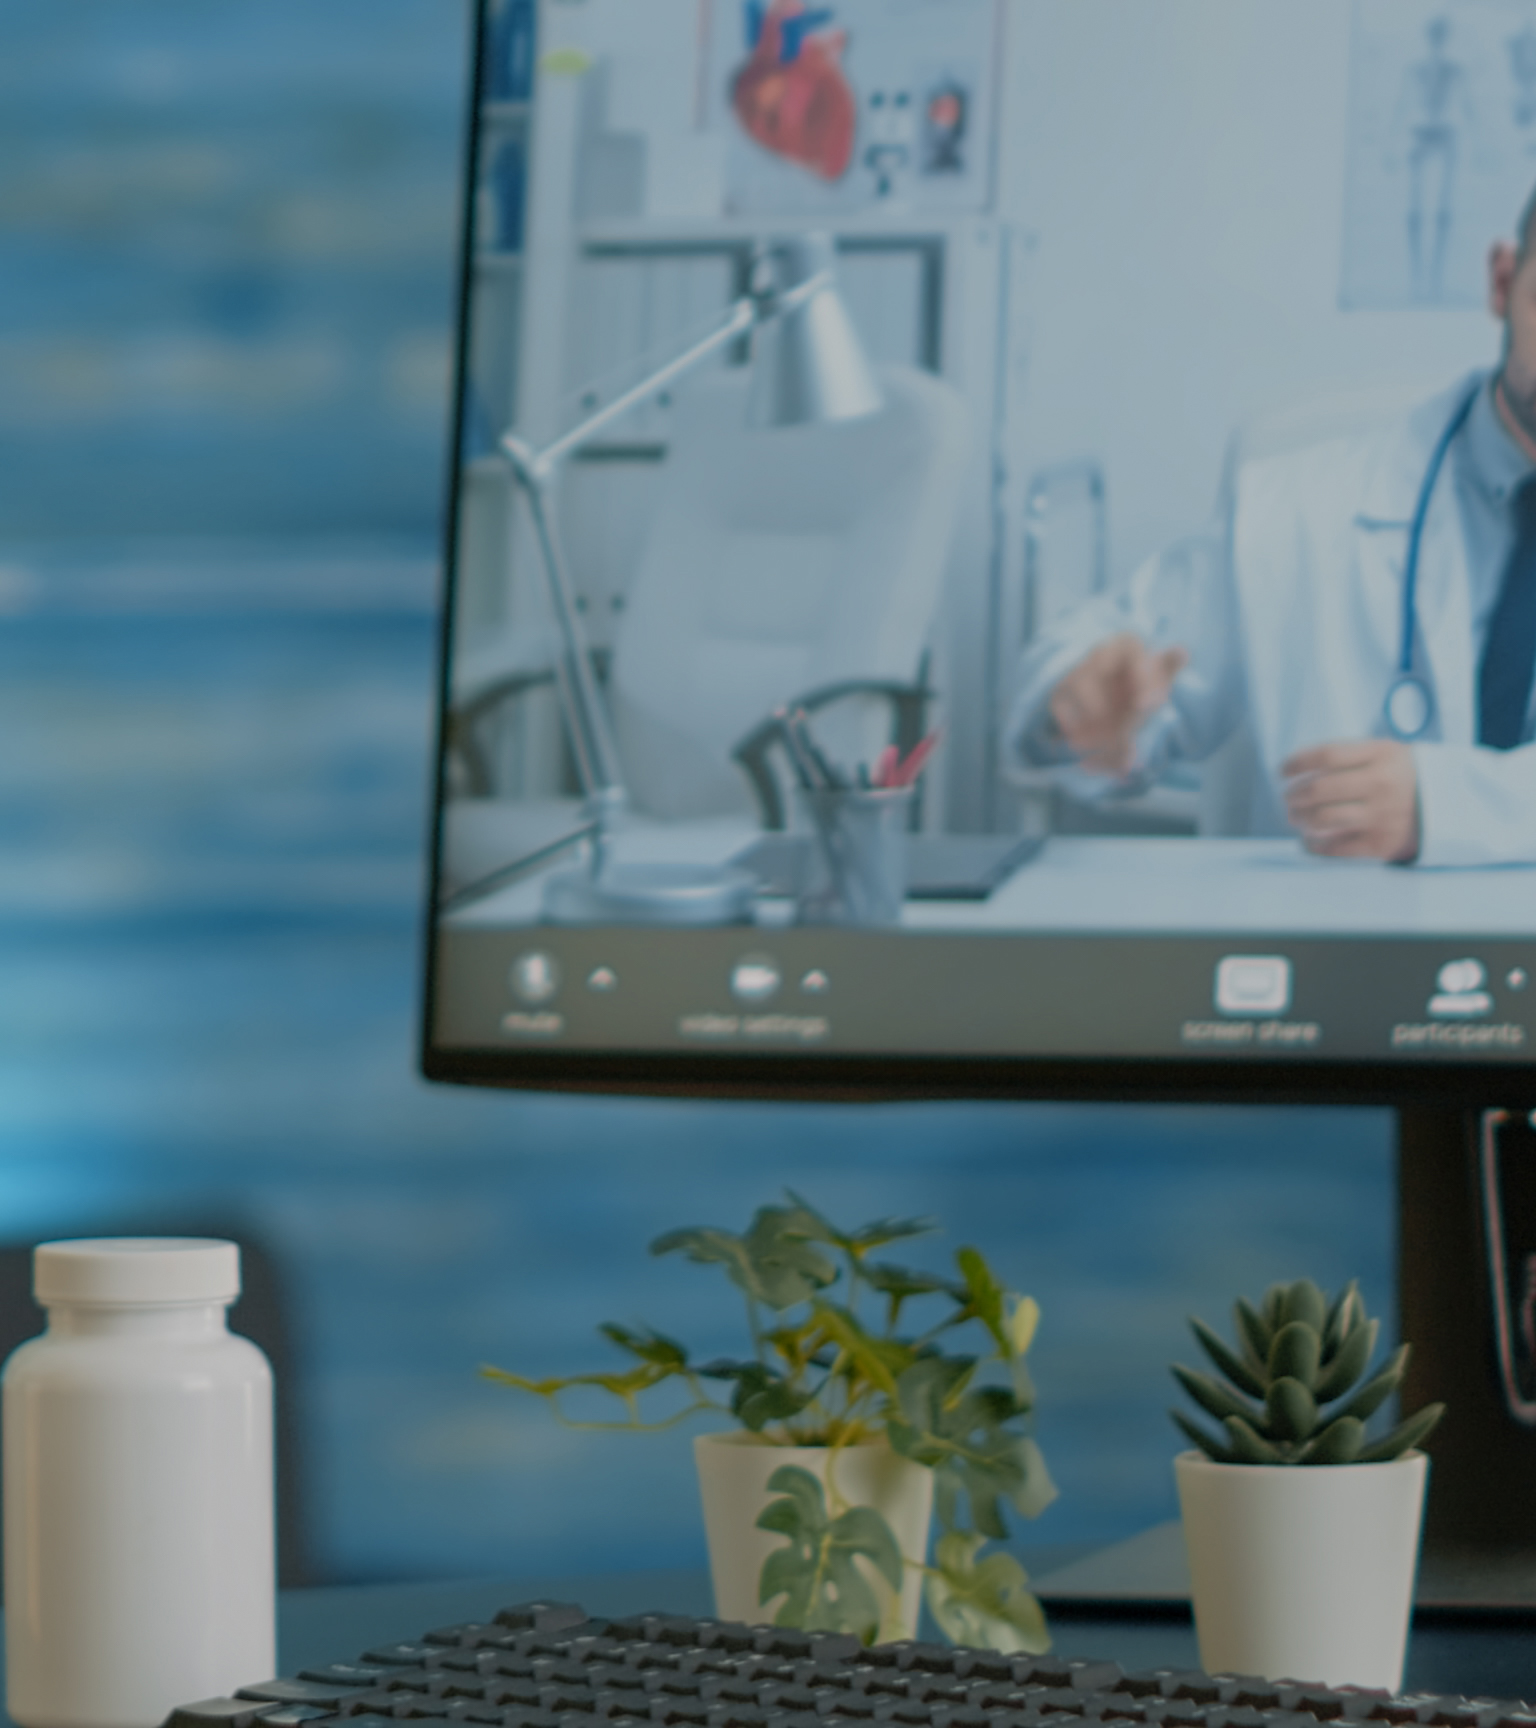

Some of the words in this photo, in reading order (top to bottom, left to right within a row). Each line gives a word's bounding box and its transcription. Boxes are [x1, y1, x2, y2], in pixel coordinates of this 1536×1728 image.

[1183, 1022, 1254, 1042] screen
[1257, 1020, 1319, 1042] share
[1392, 1022, 1523, 1047] participants
